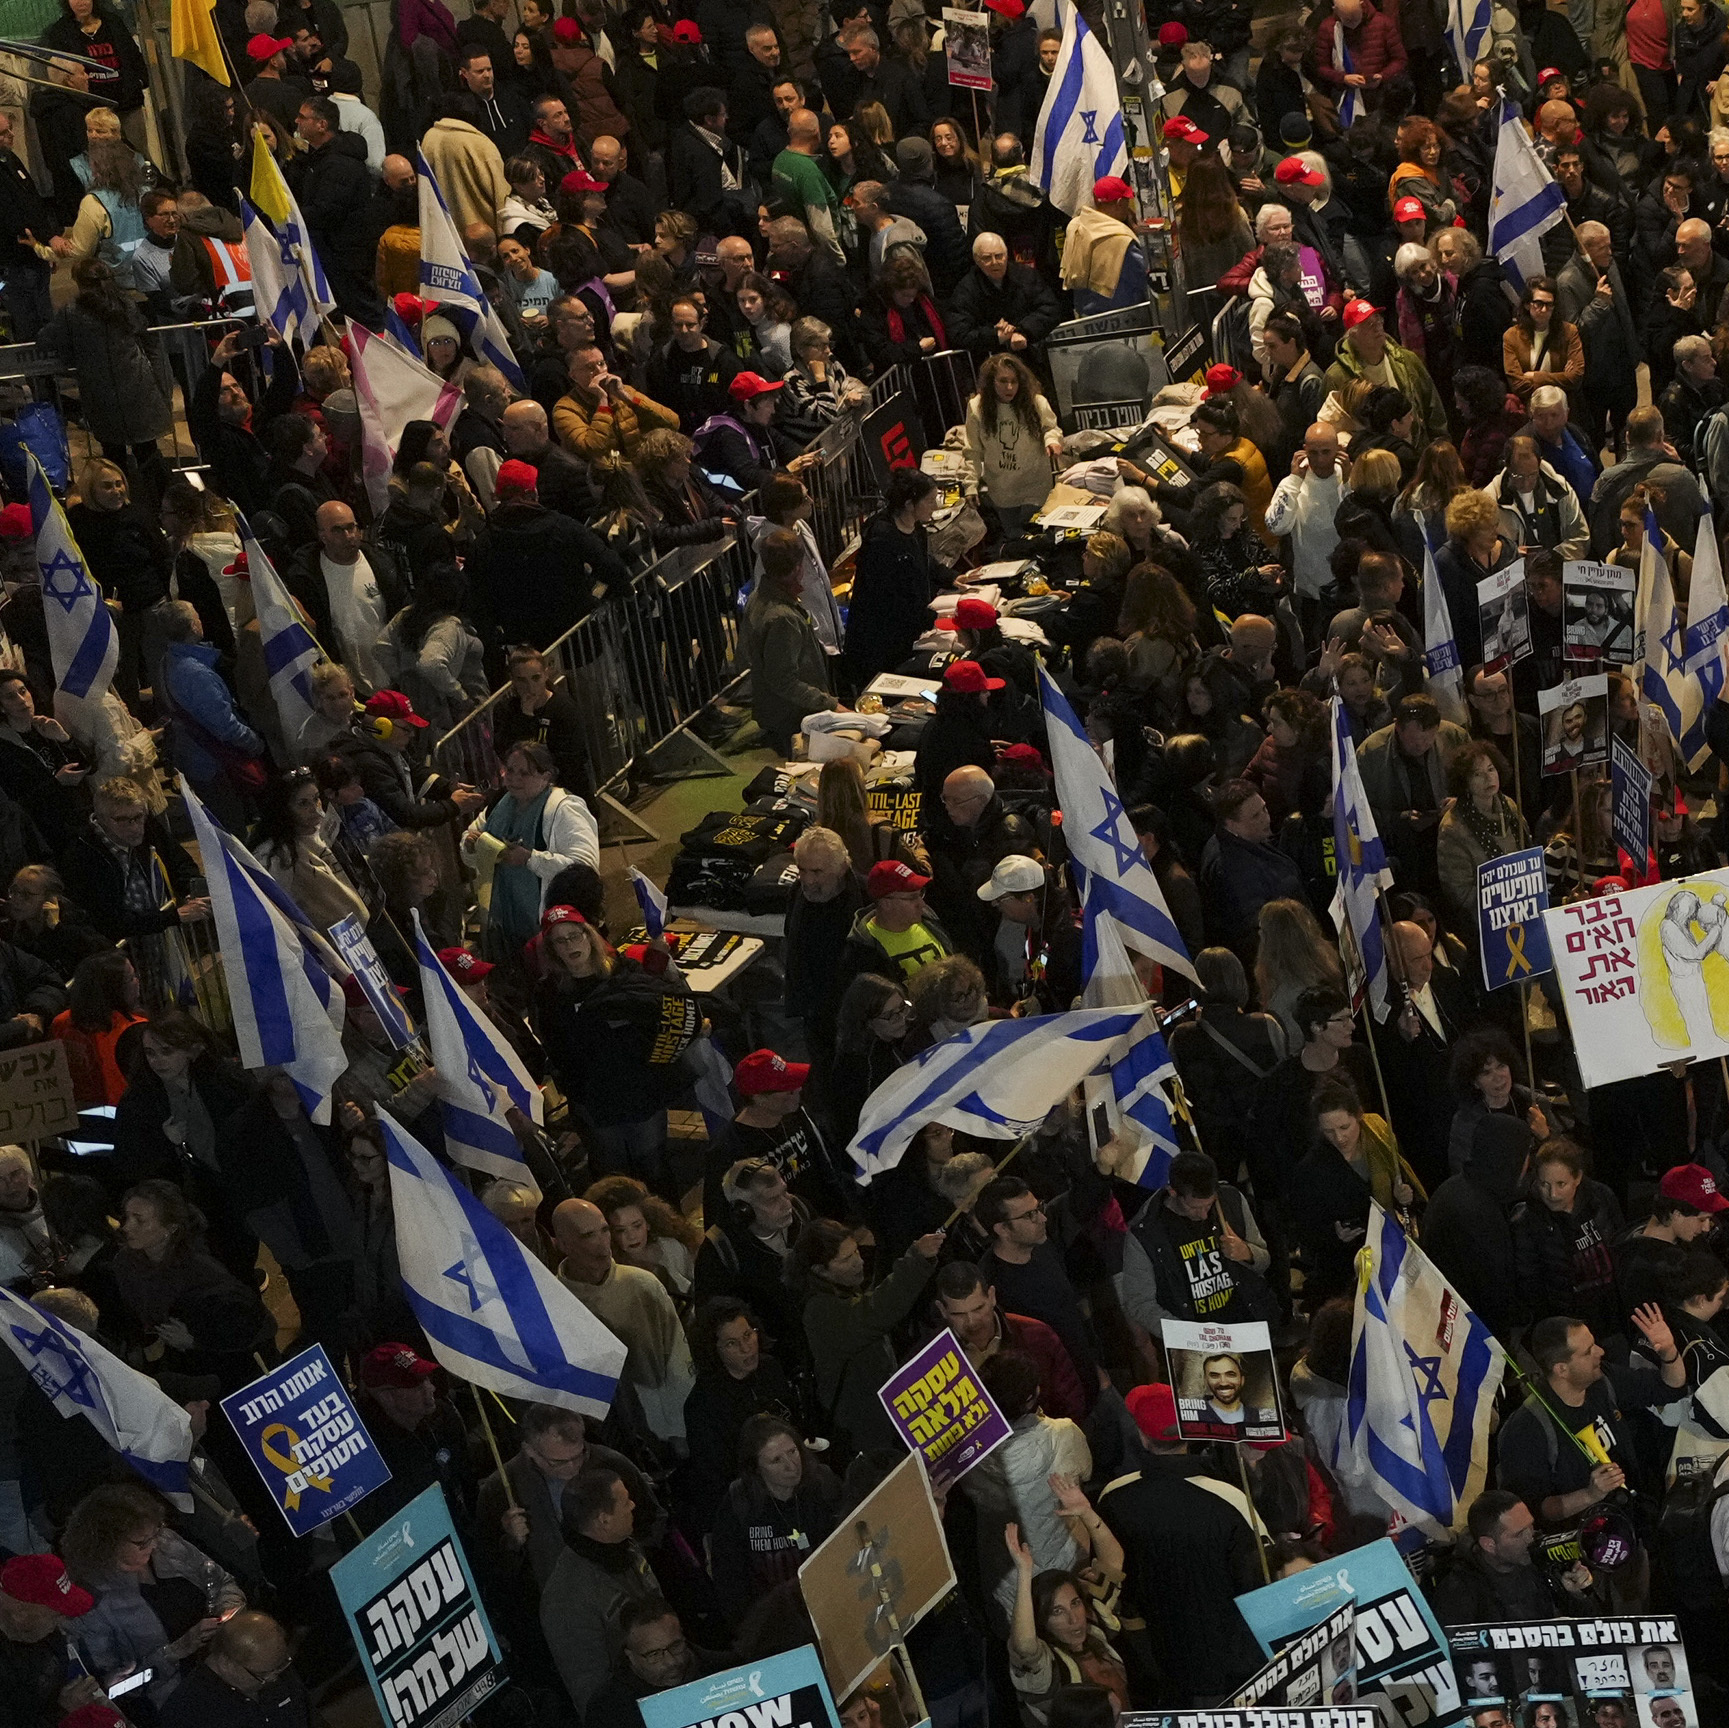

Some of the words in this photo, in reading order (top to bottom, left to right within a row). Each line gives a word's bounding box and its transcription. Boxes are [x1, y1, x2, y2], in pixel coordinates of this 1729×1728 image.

[1483, 871, 1543, 904] חופשיים
[1490, 897, 1541, 931] בארצנו
[1563, 898, 1625, 926] כבר
[1578, 948, 1632, 981] את
[1576, 976, 1637, 1007] האור
[279, 1358, 328, 1403] אנחנו
[891, 1351, 962, 1423] עסקה
[238, 1391, 279, 1427] הרוב
[297, 1390, 344, 1428] בעד
[907, 1378, 980, 1447] מלאה
[1179, 1399, 1206, 1411] BRING
[290, 1412, 356, 1465] עסקת
[284, 1434, 368, 1495] חטופים
[750, 1526, 773, 1538] BRING
[366, 1537, 469, 1664] עסקה.
